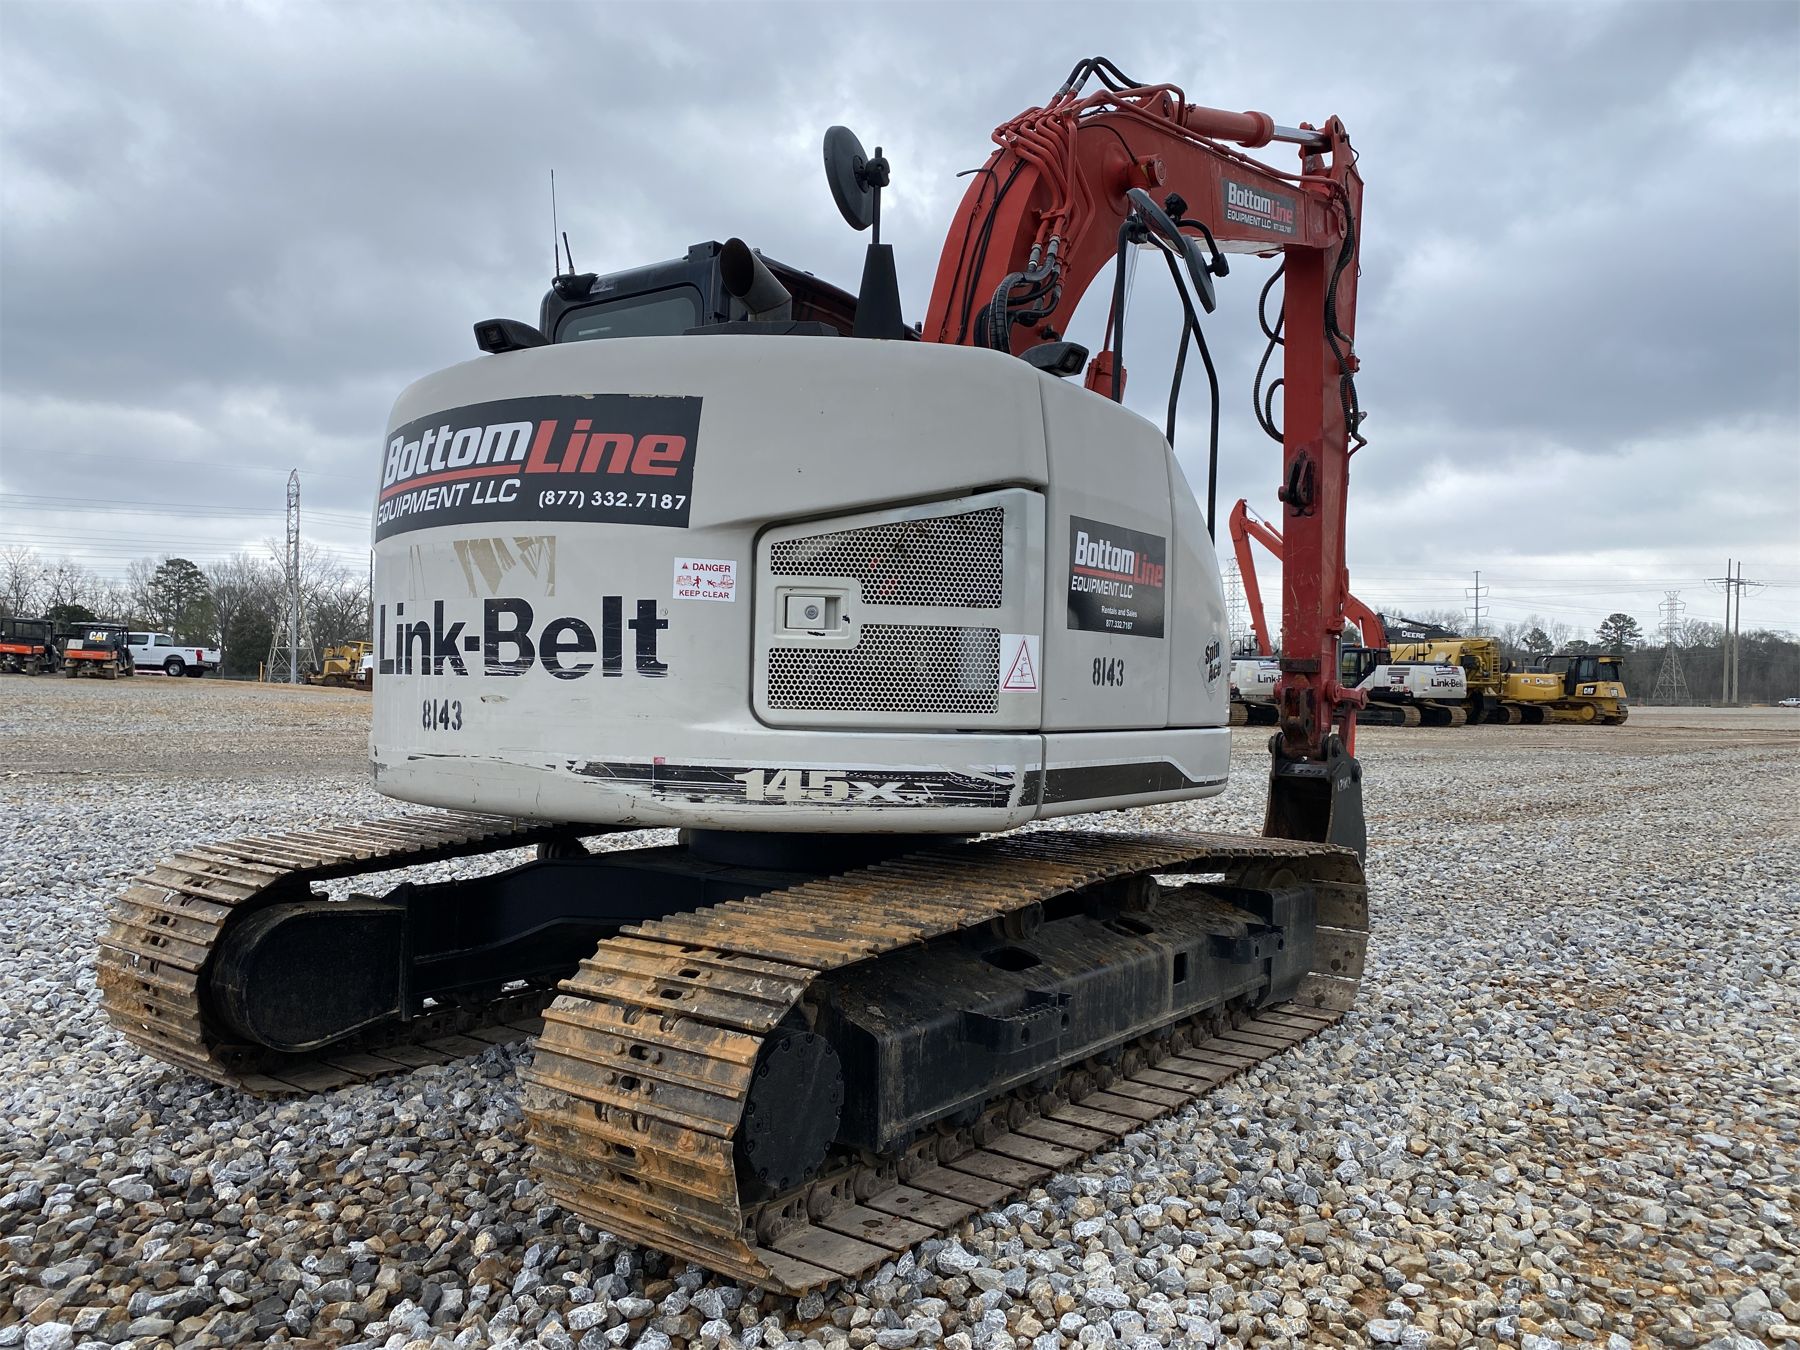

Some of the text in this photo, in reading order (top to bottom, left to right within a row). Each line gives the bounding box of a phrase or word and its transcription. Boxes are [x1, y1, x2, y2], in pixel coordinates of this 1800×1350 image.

[1228, 182, 1293, 223] BottomLine
[1228, 209, 1260, 225] EQUIPMENT
[1262, 220, 1272, 229] LLC
[383, 419, 687, 489] BottomLine
[377, 478, 686, 527] EQUIPMENT LLC (877) 332.7187
[692, 562, 731, 573] DANGER
[1075, 530, 1164, 588] BottomLine
[679, 589, 730, 599] KEEP CLEAR
[1071, 575, 1133, 599] EQUIPMENT LLC
[1126, 608, 1137, 618] Sales
[88, 631, 109, 641] CAT
[379, 595, 669, 680] Link-Belt
[1401, 630, 1426, 639] DEERE
[1092, 657, 1125, 687] 8143
[1257, 673, 1282, 684] Link-B
[422, 698, 463, 731] 8143
